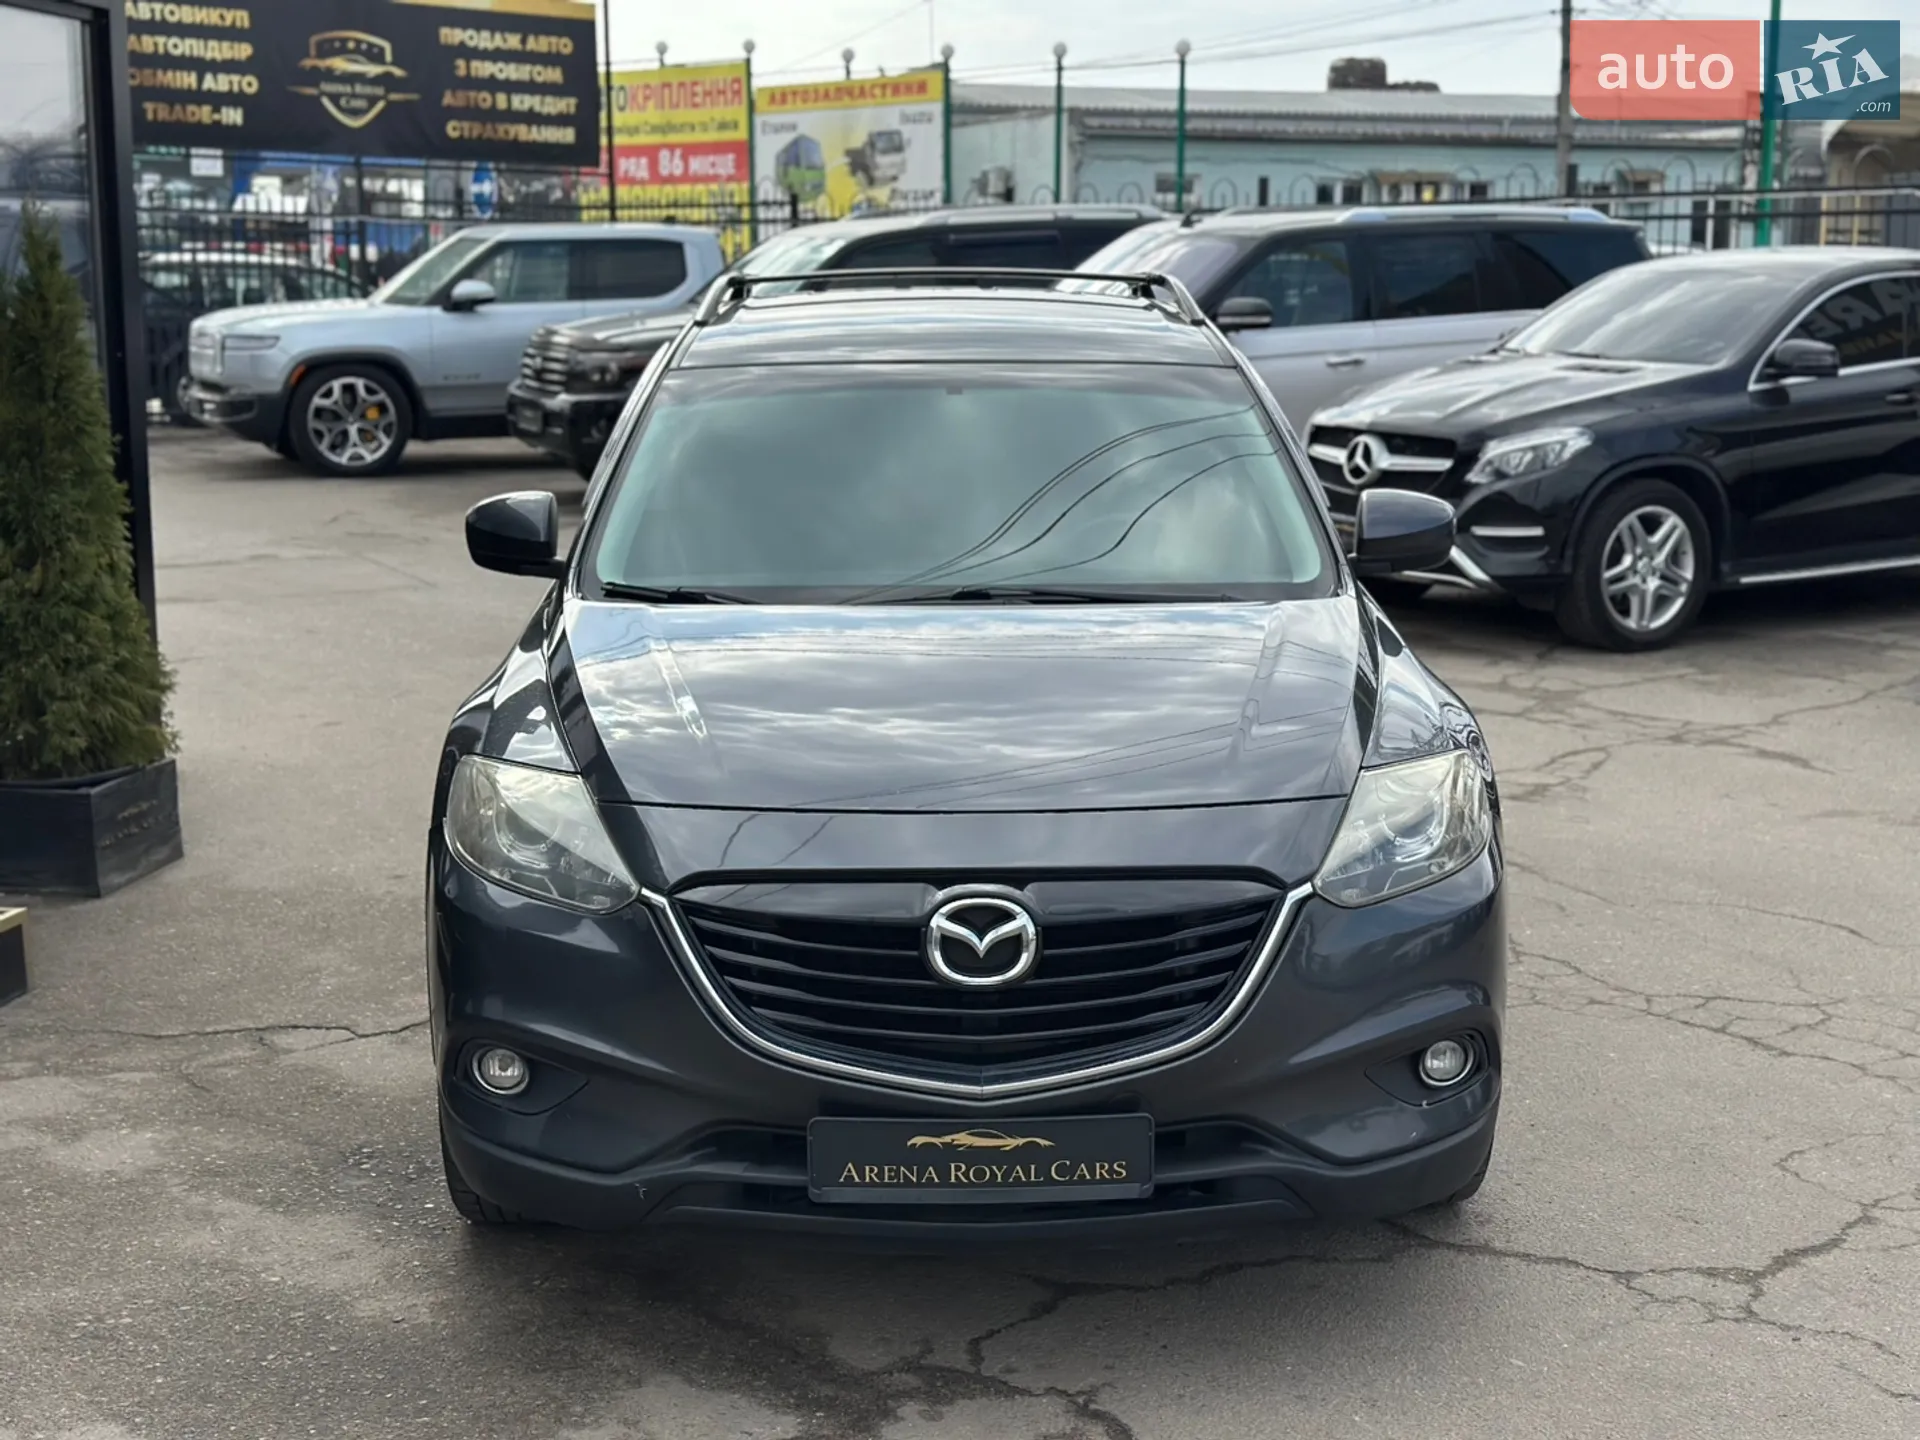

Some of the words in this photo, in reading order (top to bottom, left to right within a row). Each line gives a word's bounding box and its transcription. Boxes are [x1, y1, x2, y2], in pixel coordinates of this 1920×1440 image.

[127, 34, 253, 62] АВТОПІДБІР
[438, 26, 523, 51] ПРОДАЖ
[525, 34, 574, 55] АВТО
[128, 68, 198, 90] ОБМІН
[201, 72, 259, 95] АВТО
[469, 59, 564, 84] ПРОБІГОМ
[441, 89, 493, 109] АВТО
[495, 91, 508, 111] В
[510, 92, 579, 116] КРЕДИТ
[768, 80, 928, 106] АВТОЗАПЧАСТИНИ
[142, 101, 243, 126] TRADE-IN
[445, 119, 576, 145] СТРАХУВАННЯ
[618, 157, 649, 180] РЯД
[659, 148, 684, 176] 86
[688, 153, 736, 181] МІСЦЕ
[838, 1162, 940, 1183] ARENA
[950, 1162, 1043, 1183] ROYAL
[1050, 1160, 1127, 1181] CARS
